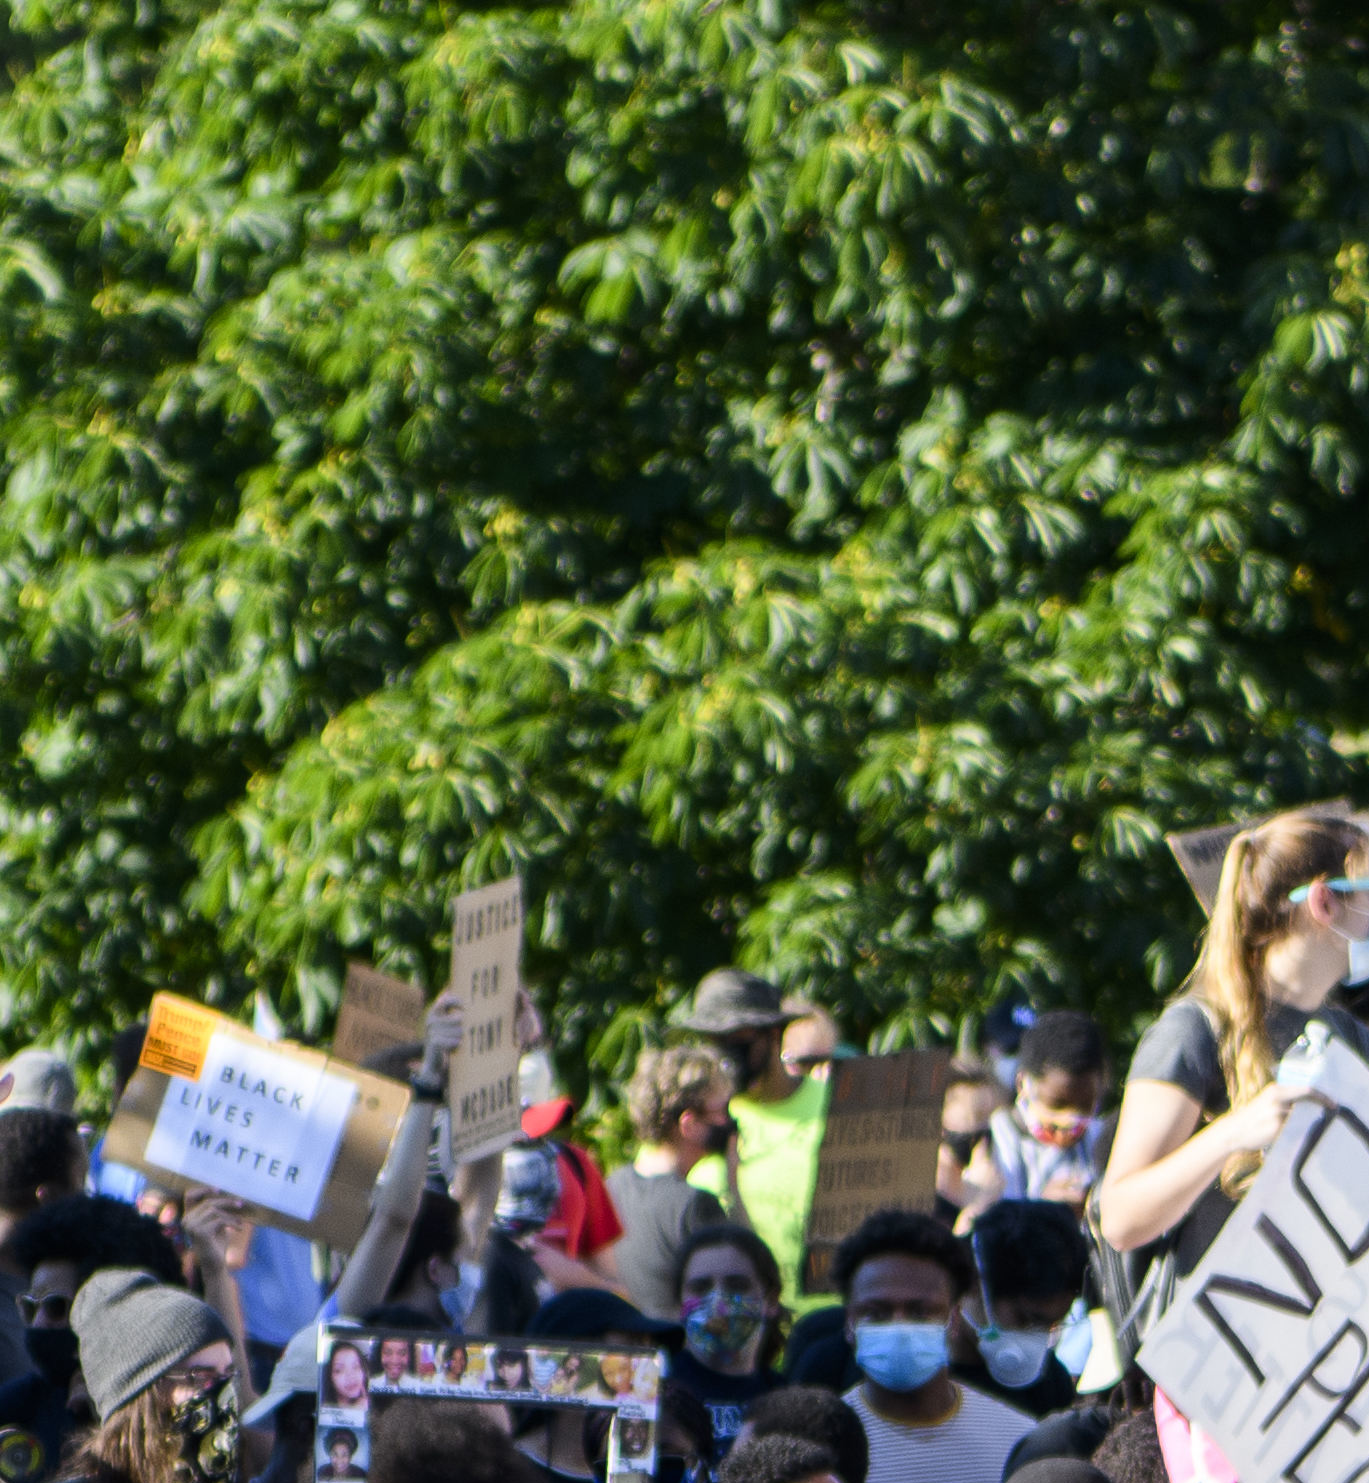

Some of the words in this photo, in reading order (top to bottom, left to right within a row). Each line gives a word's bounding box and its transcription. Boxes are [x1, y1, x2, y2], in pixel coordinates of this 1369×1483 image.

[180, 1087, 255, 1129] LIVES
[219, 1065, 305, 1111] BLACK
[190, 1129, 301, 1185] MATTER
